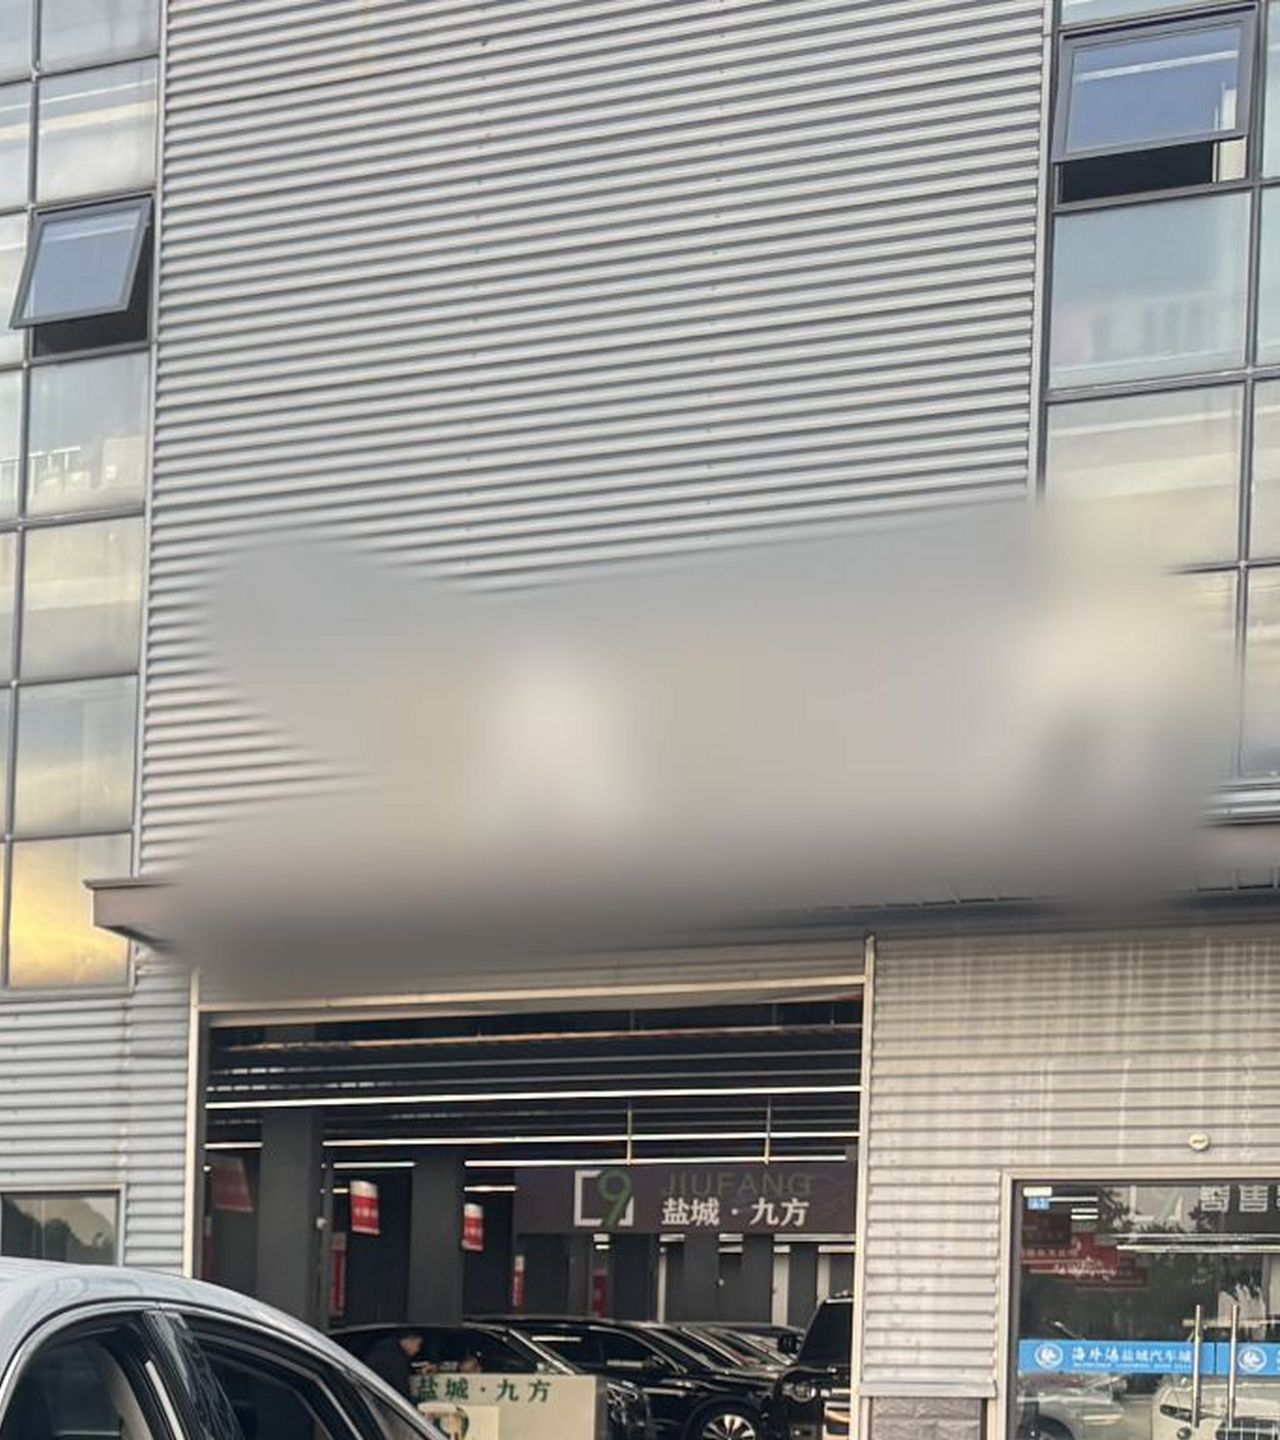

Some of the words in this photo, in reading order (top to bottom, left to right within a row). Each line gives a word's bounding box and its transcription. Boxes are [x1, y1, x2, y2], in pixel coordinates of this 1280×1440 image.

[662, 1171, 812, 1196] JIUFANG
[661, 1197, 811, 1227] 盐城·九方
[417, 1376, 553, 1403] 盐城·九方
